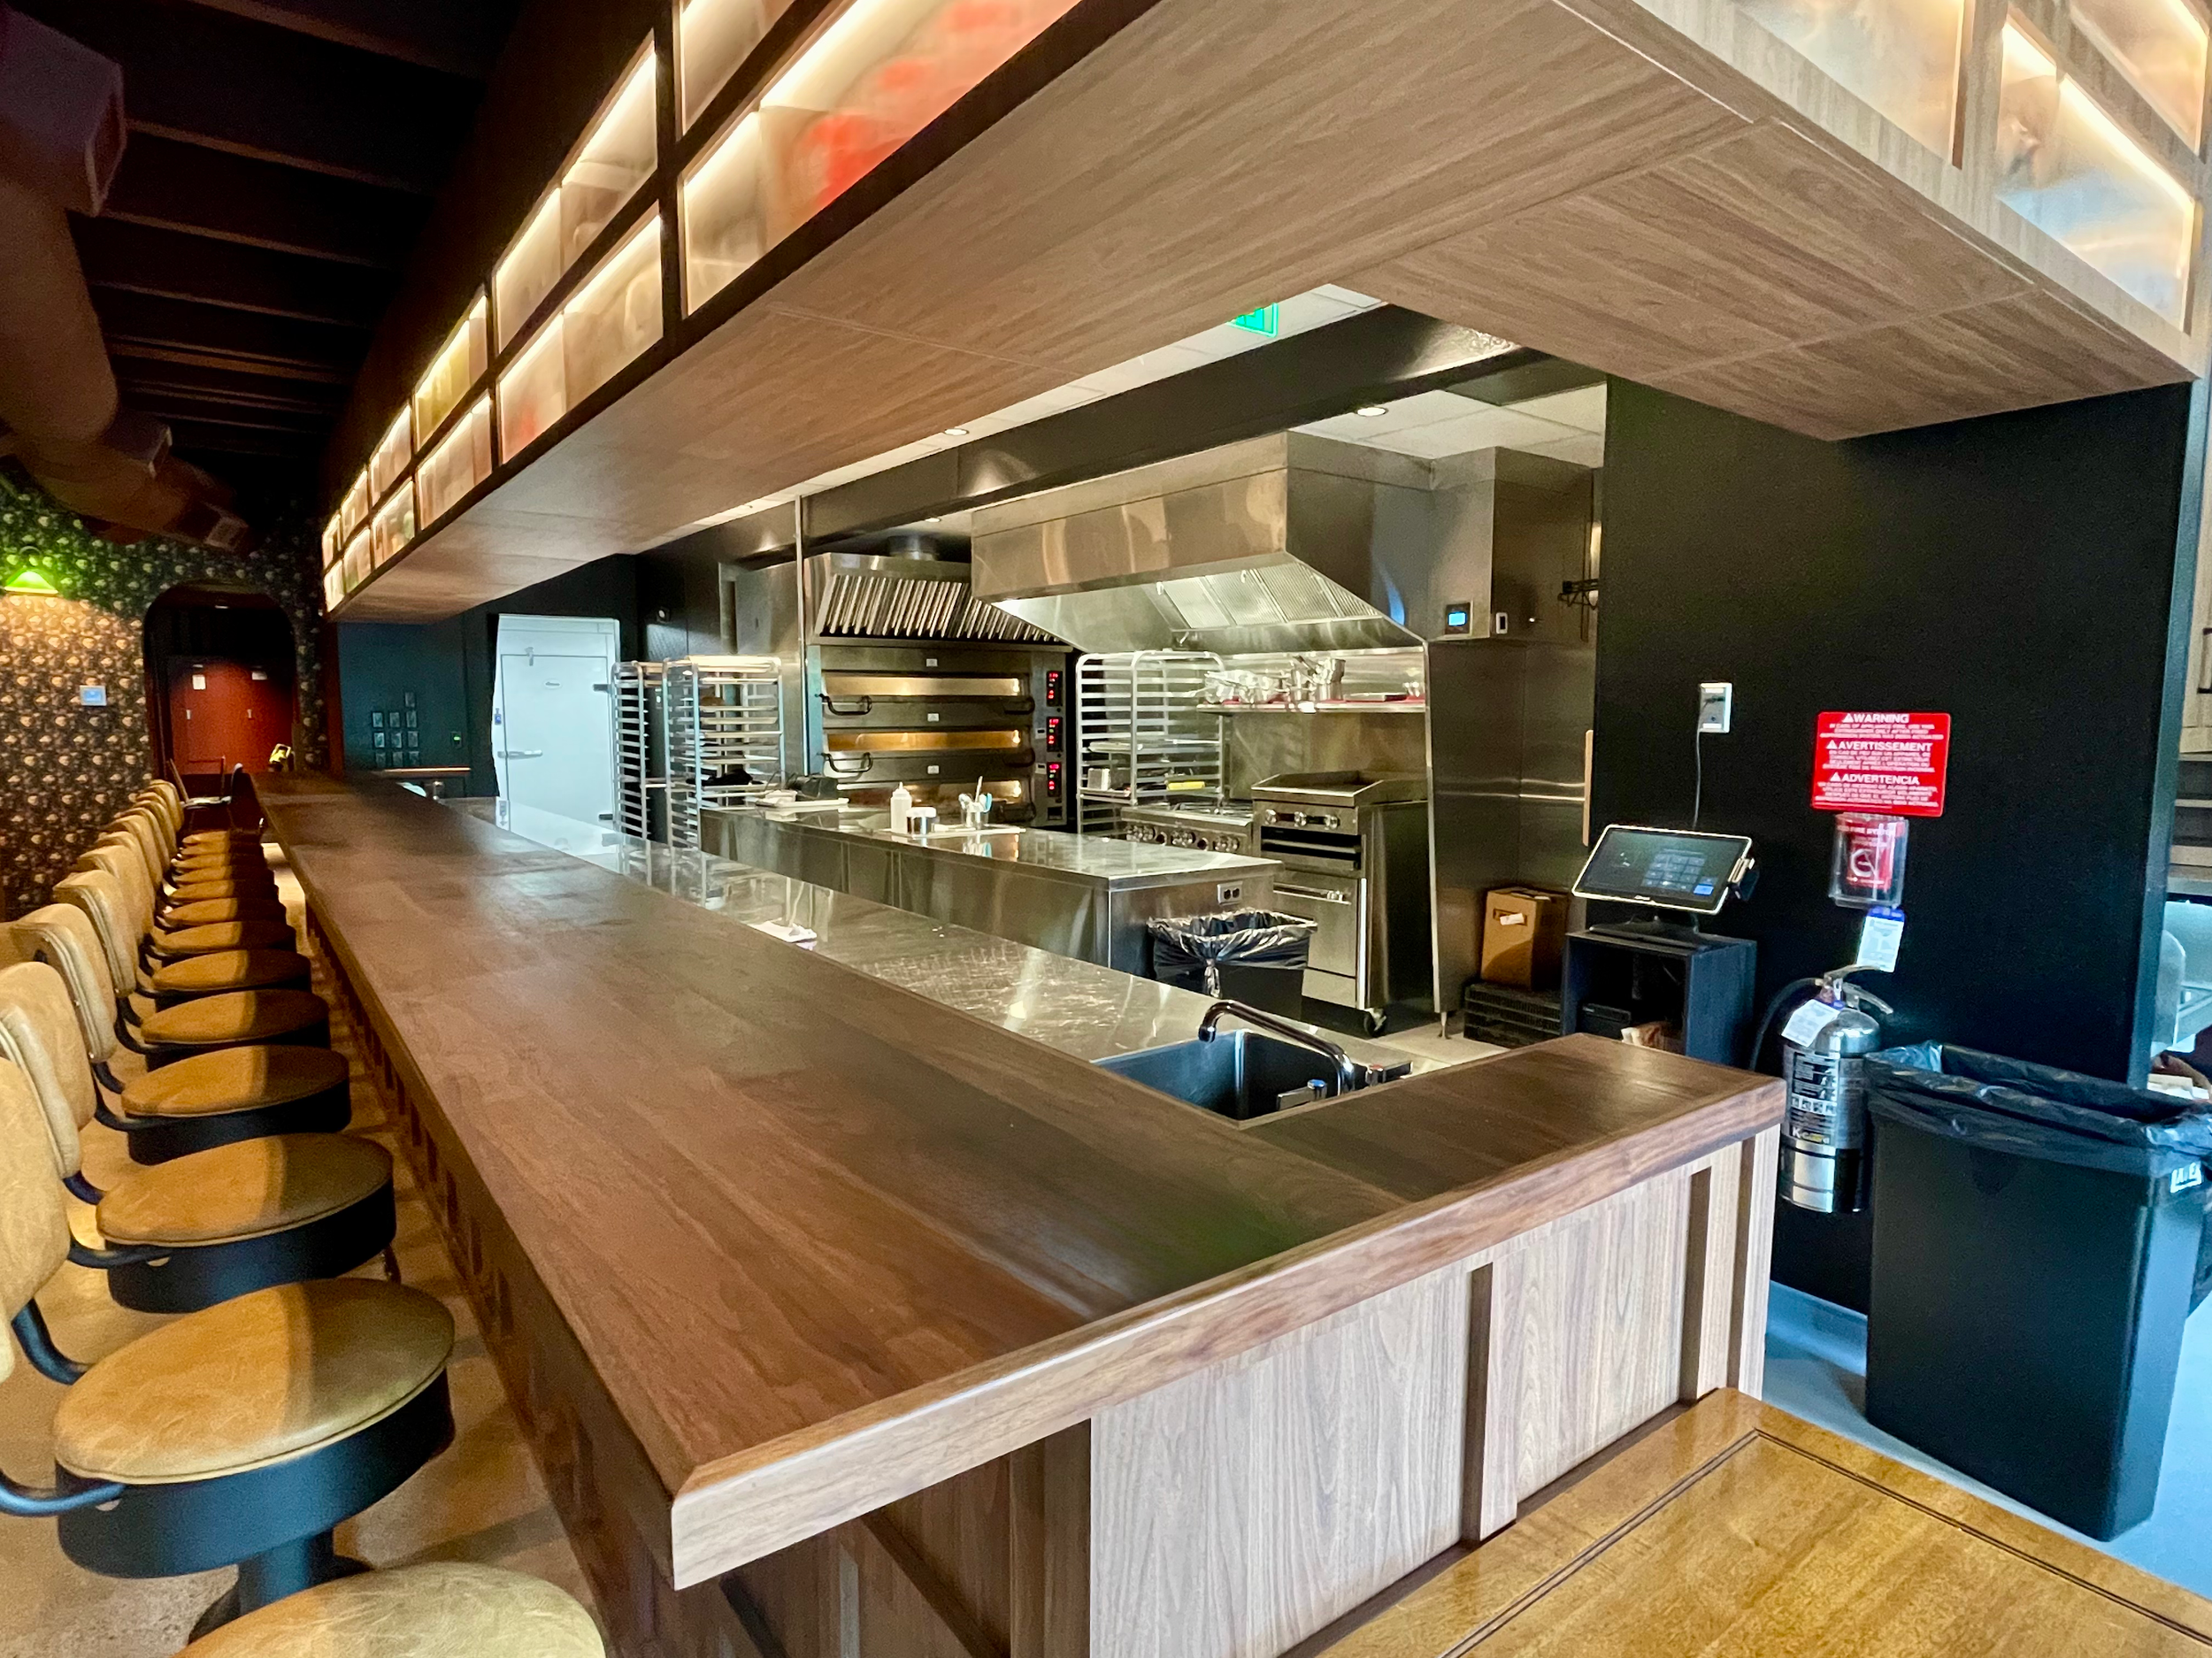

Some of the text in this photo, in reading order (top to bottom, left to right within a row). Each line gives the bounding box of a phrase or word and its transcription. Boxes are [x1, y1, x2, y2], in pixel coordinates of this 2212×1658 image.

[1853, 714, 1909, 723] WARNING
[1838, 741, 1932, 751] AVERTISSEMENT
[1842, 774, 1919, 785] ADVERTENCIA
